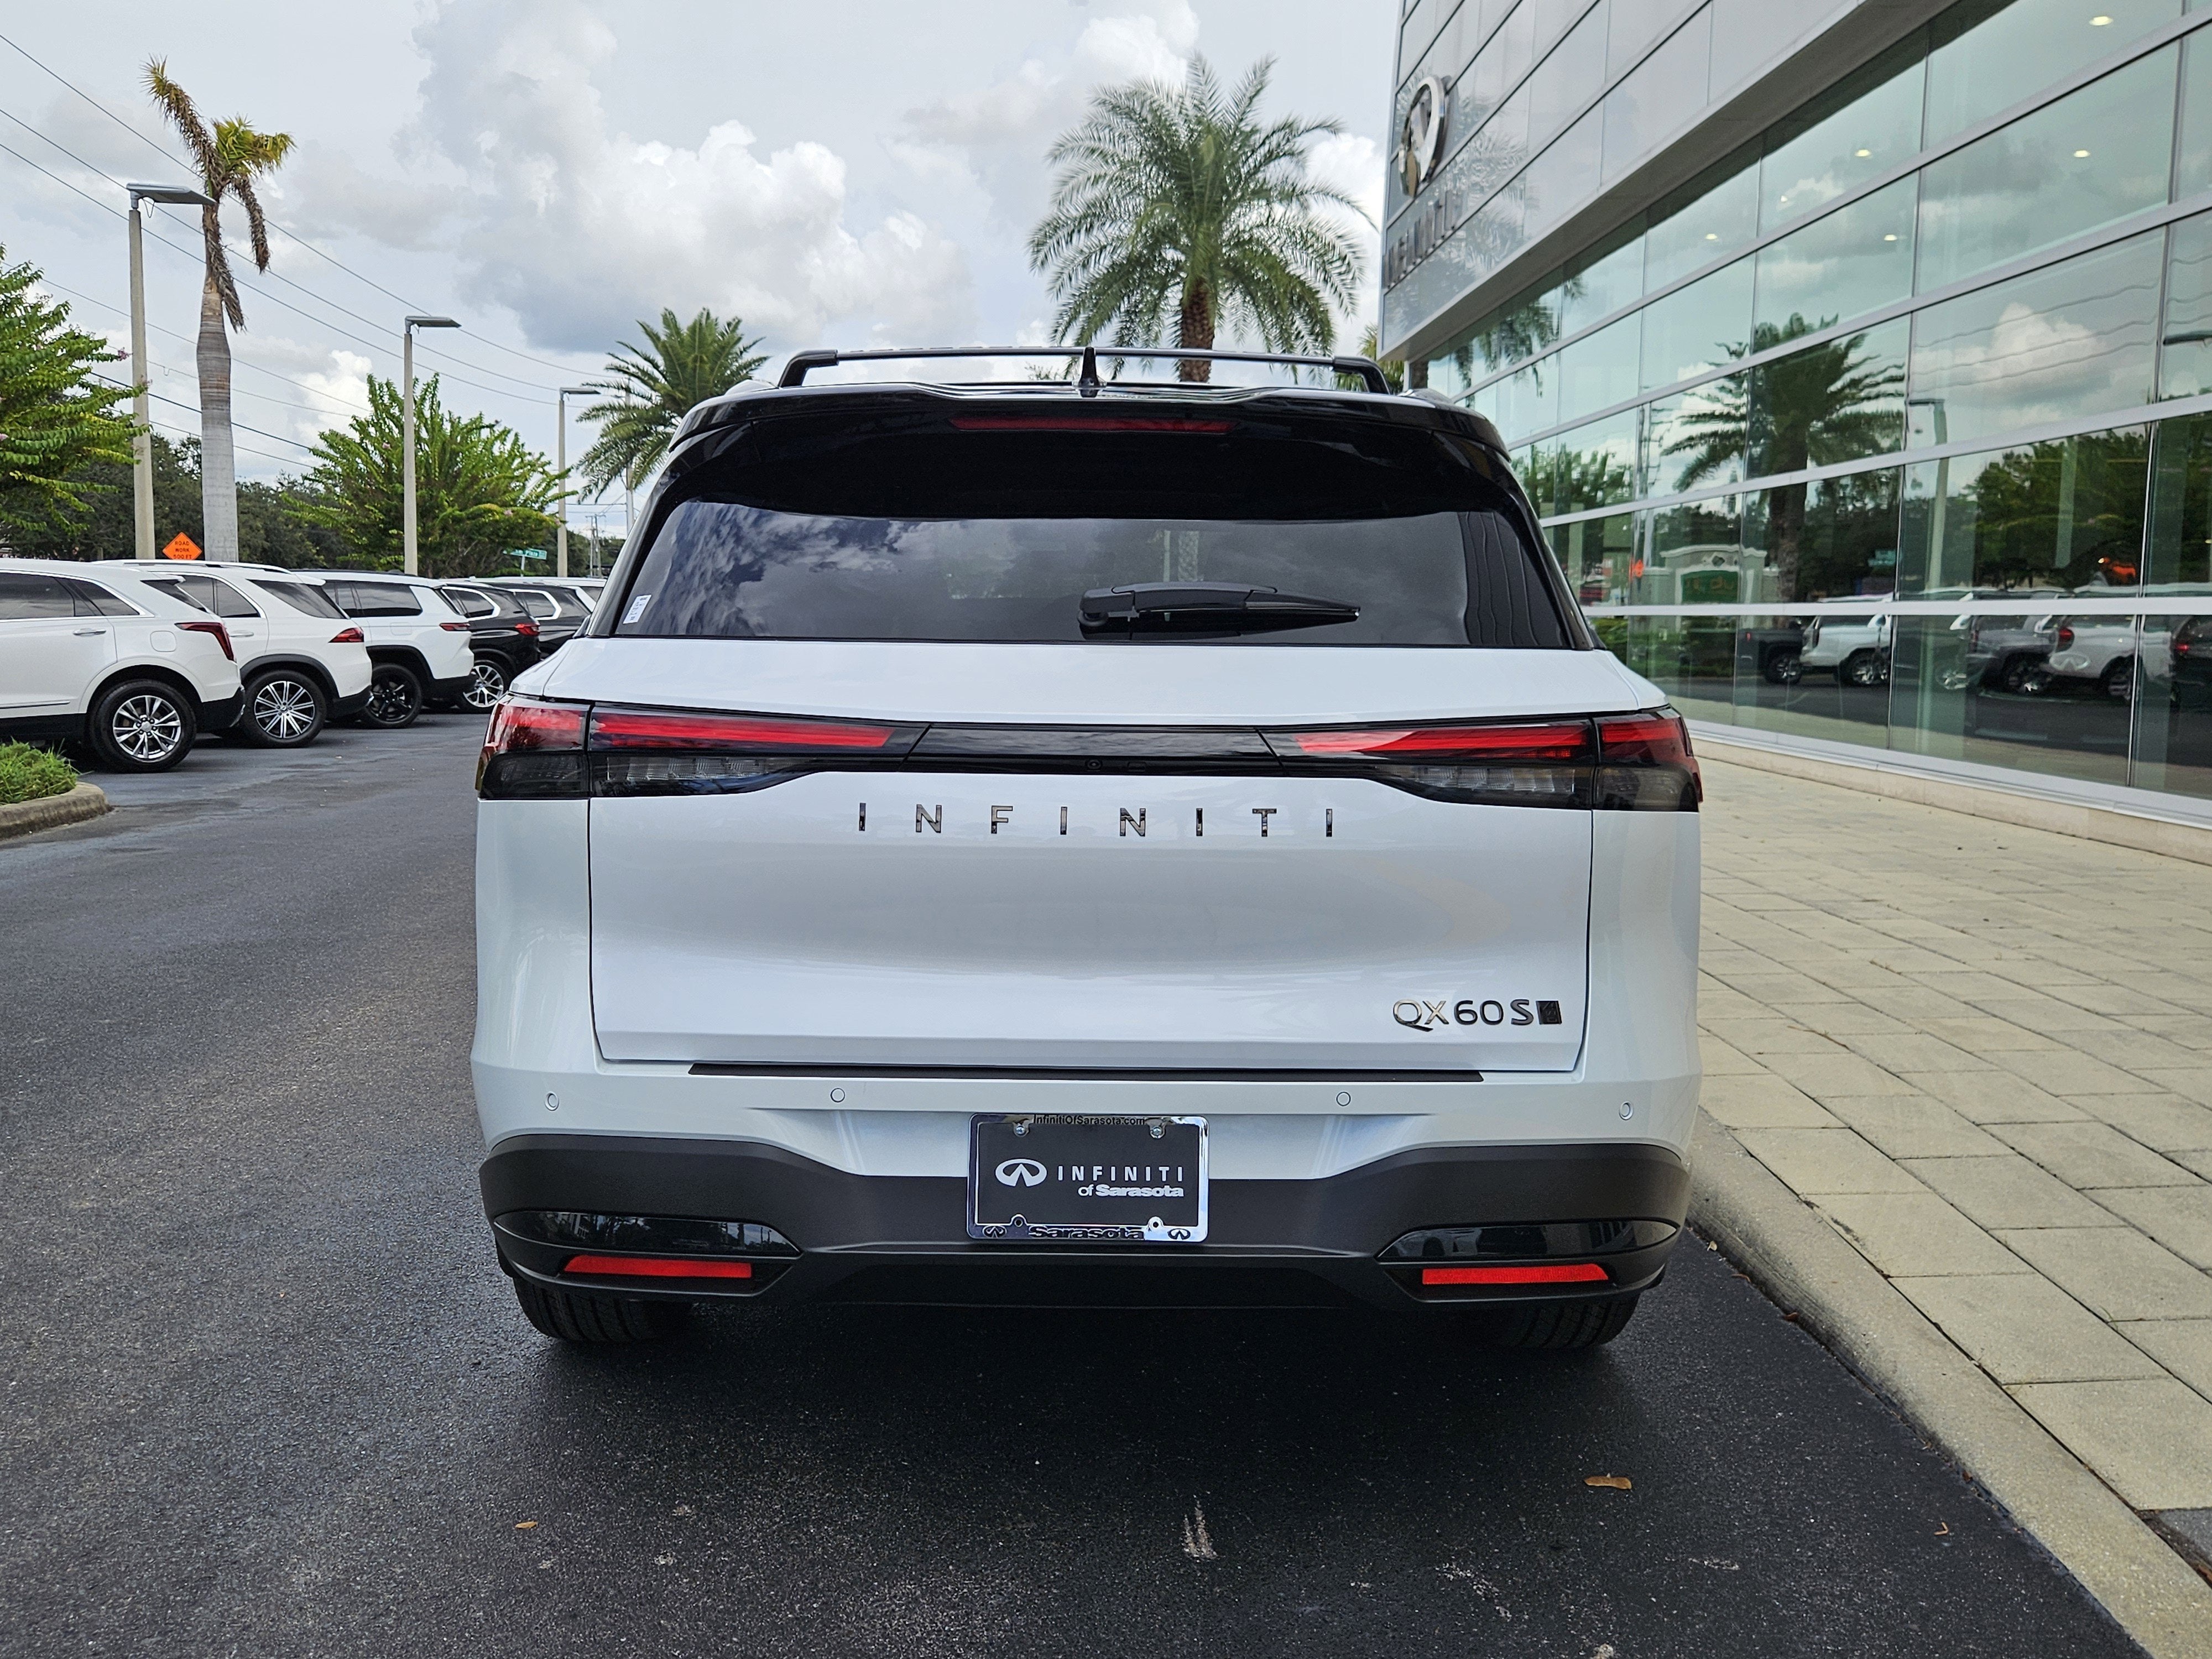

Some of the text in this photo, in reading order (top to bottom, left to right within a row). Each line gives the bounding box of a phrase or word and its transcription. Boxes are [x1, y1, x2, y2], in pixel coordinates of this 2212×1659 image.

[858, 802, 1333, 837] INFINITI
[1034, 1114, 1145, 1125] InfinitiOfSarasota.com
[1057, 1166, 1182, 1181] INFINITI
[1078, 1184, 1184, 1197] of Sarasota
[1029, 1226, 1145, 1239] Sarasota
